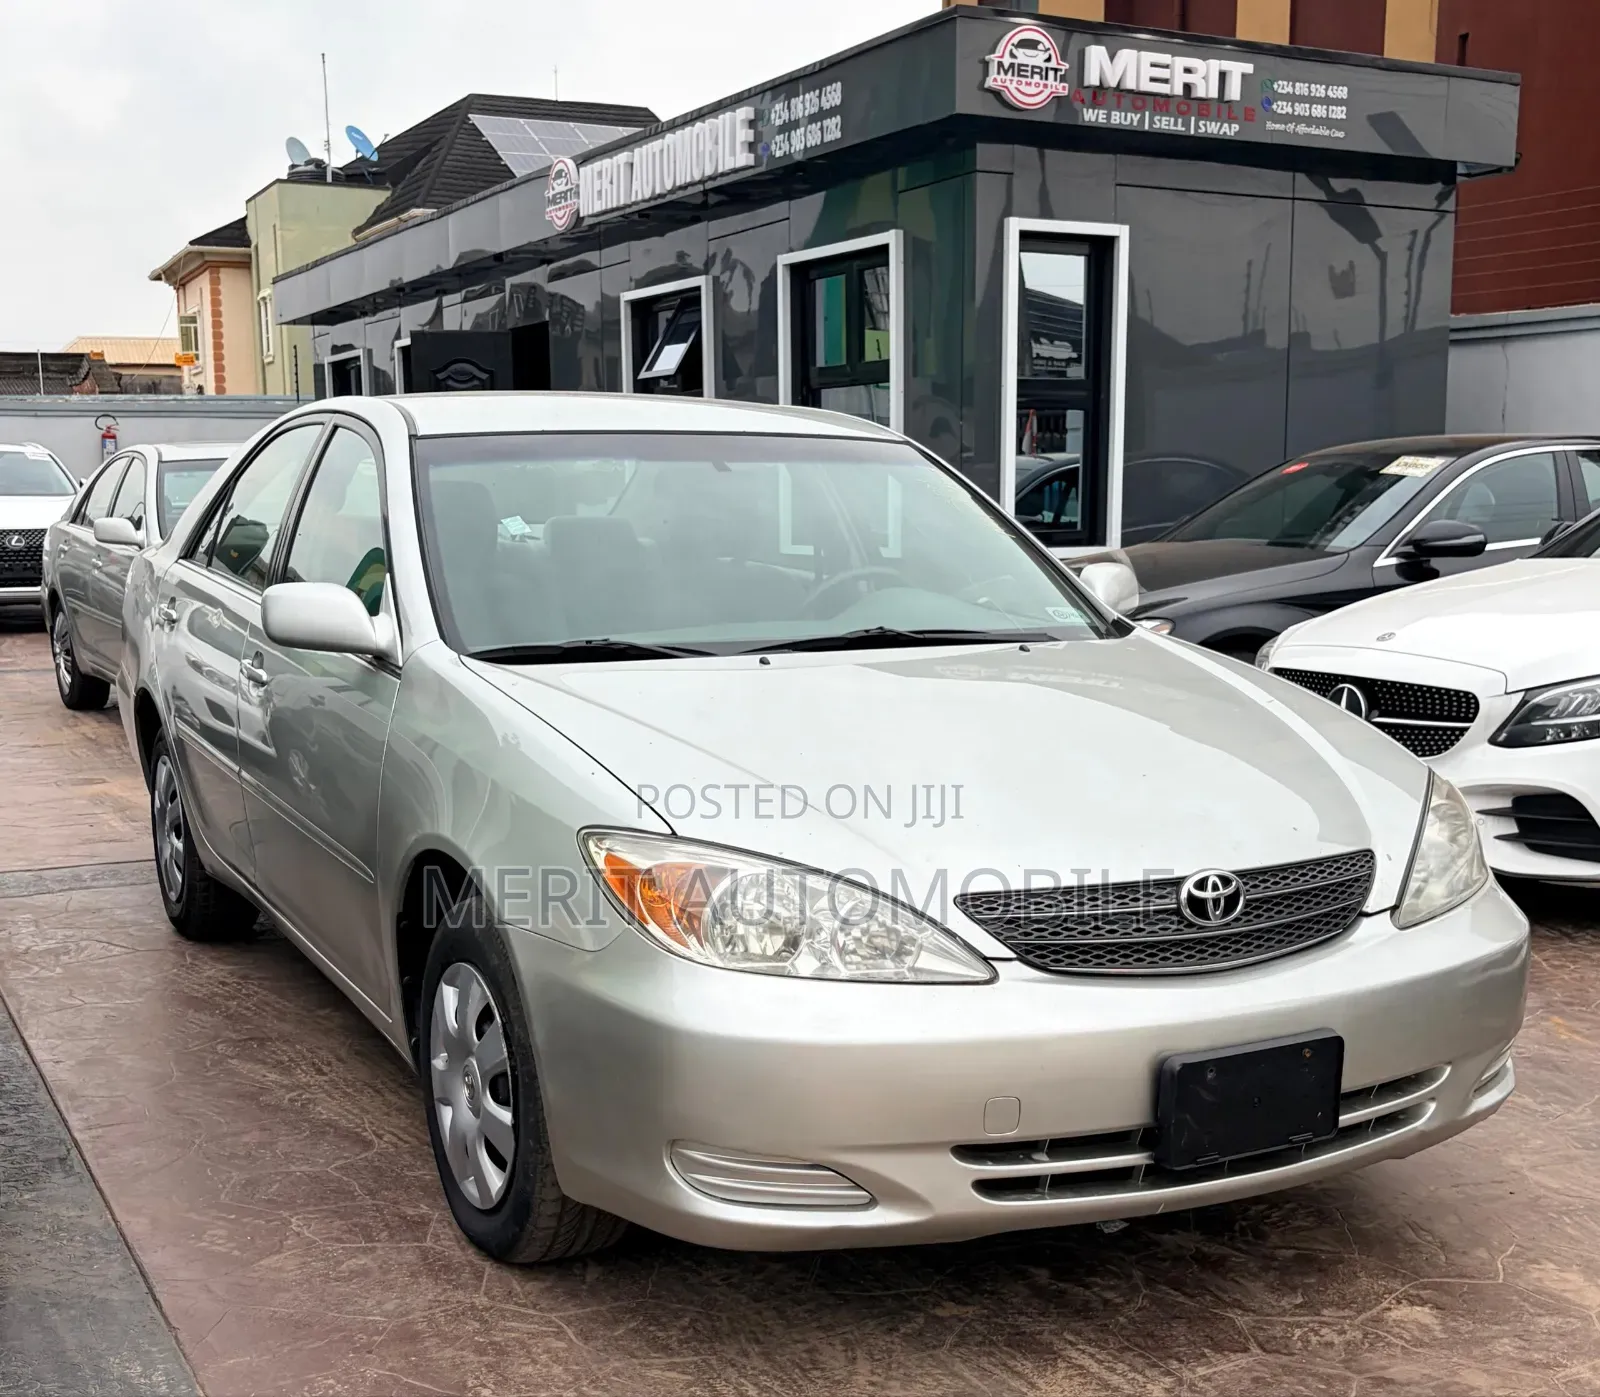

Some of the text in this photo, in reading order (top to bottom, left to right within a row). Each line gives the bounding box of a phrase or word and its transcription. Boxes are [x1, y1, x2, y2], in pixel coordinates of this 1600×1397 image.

[992, 77, 1067, 91] AUTOMOBILE
[997, 61, 1063, 83] MERIT
[1083, 45, 1254, 101] MERIT
[1273, 80, 1348, 99] +234 816 926 4568
[1071, 89, 1256, 123] AUTOMOBILE
[1272, 101, 1347, 119] +234 903 686 1282
[790, 127, 805, 153] 903
[823, 115, 842, 143] 1282
[1082, 108, 1240, 136] WE BUY SELL SWAP
[579, 106, 755, 218] MERIT AUTOMOBILE
[549, 188, 574, 207] MERIT
